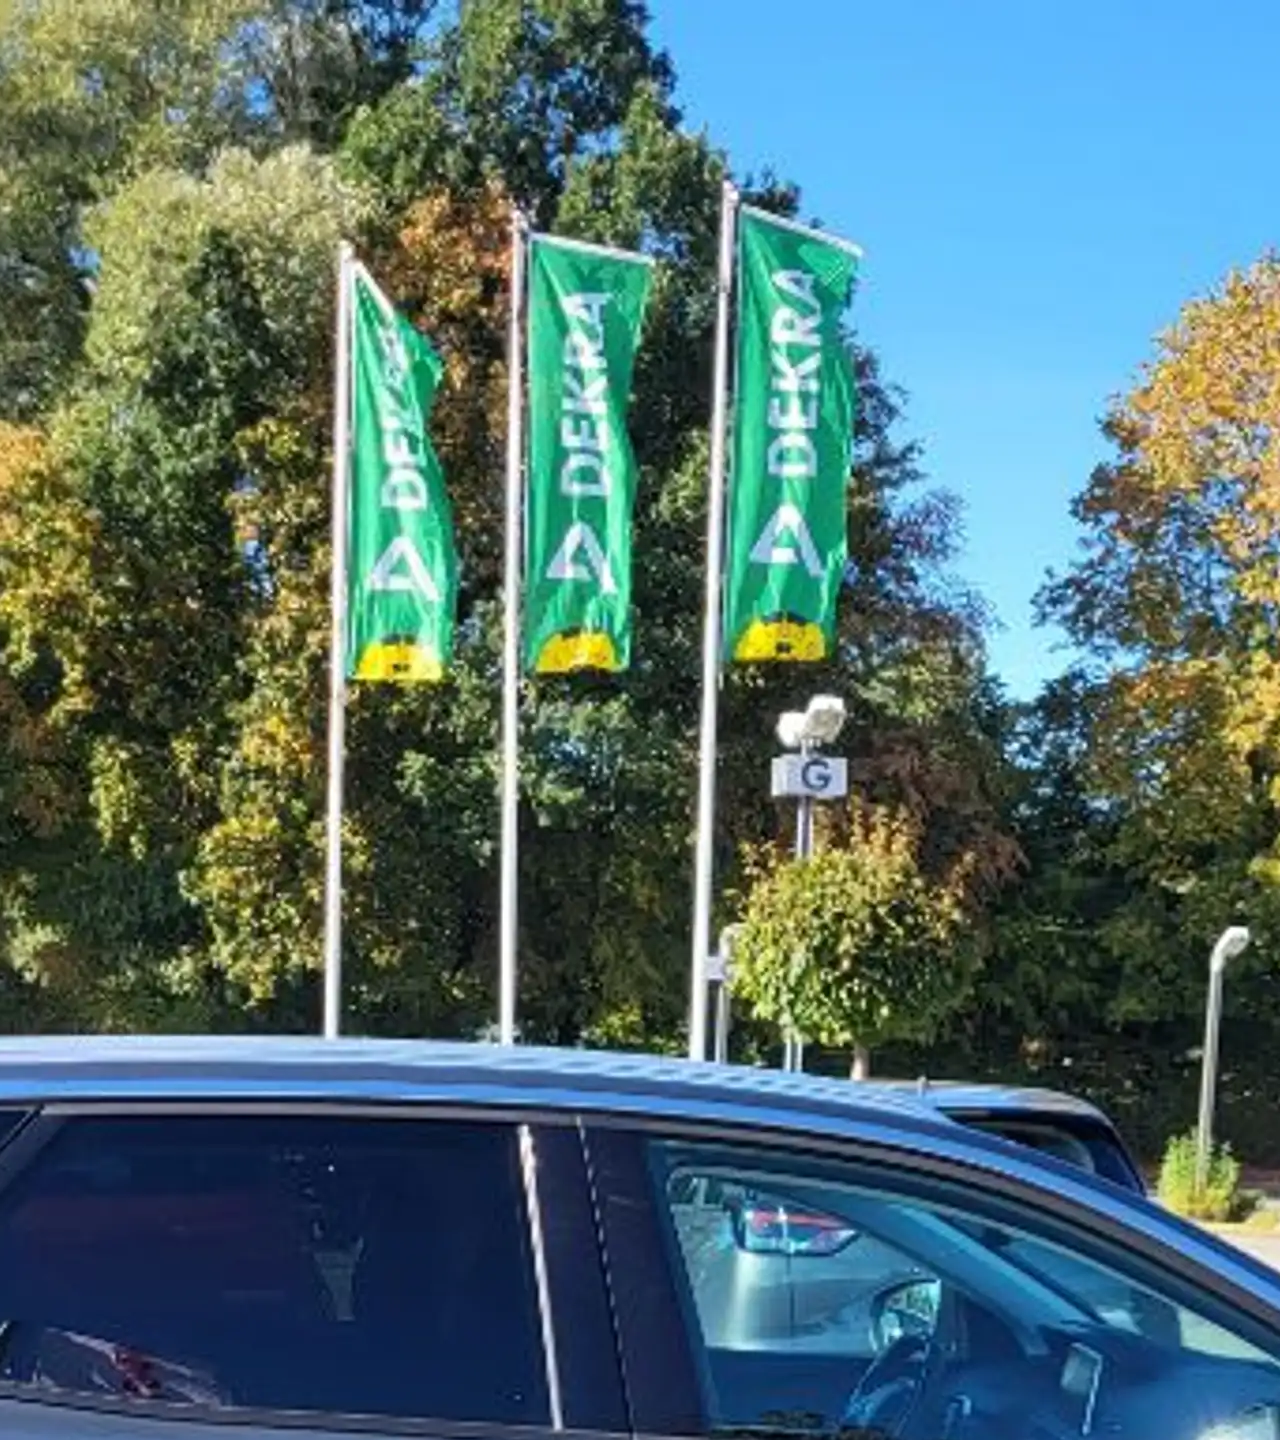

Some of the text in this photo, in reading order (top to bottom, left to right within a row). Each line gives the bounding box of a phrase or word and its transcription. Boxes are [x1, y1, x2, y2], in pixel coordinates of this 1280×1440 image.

[560, 292, 612, 496] DEKRA
[768, 269, 822, 478] DEKRA
[801, 761, 832, 791] G
